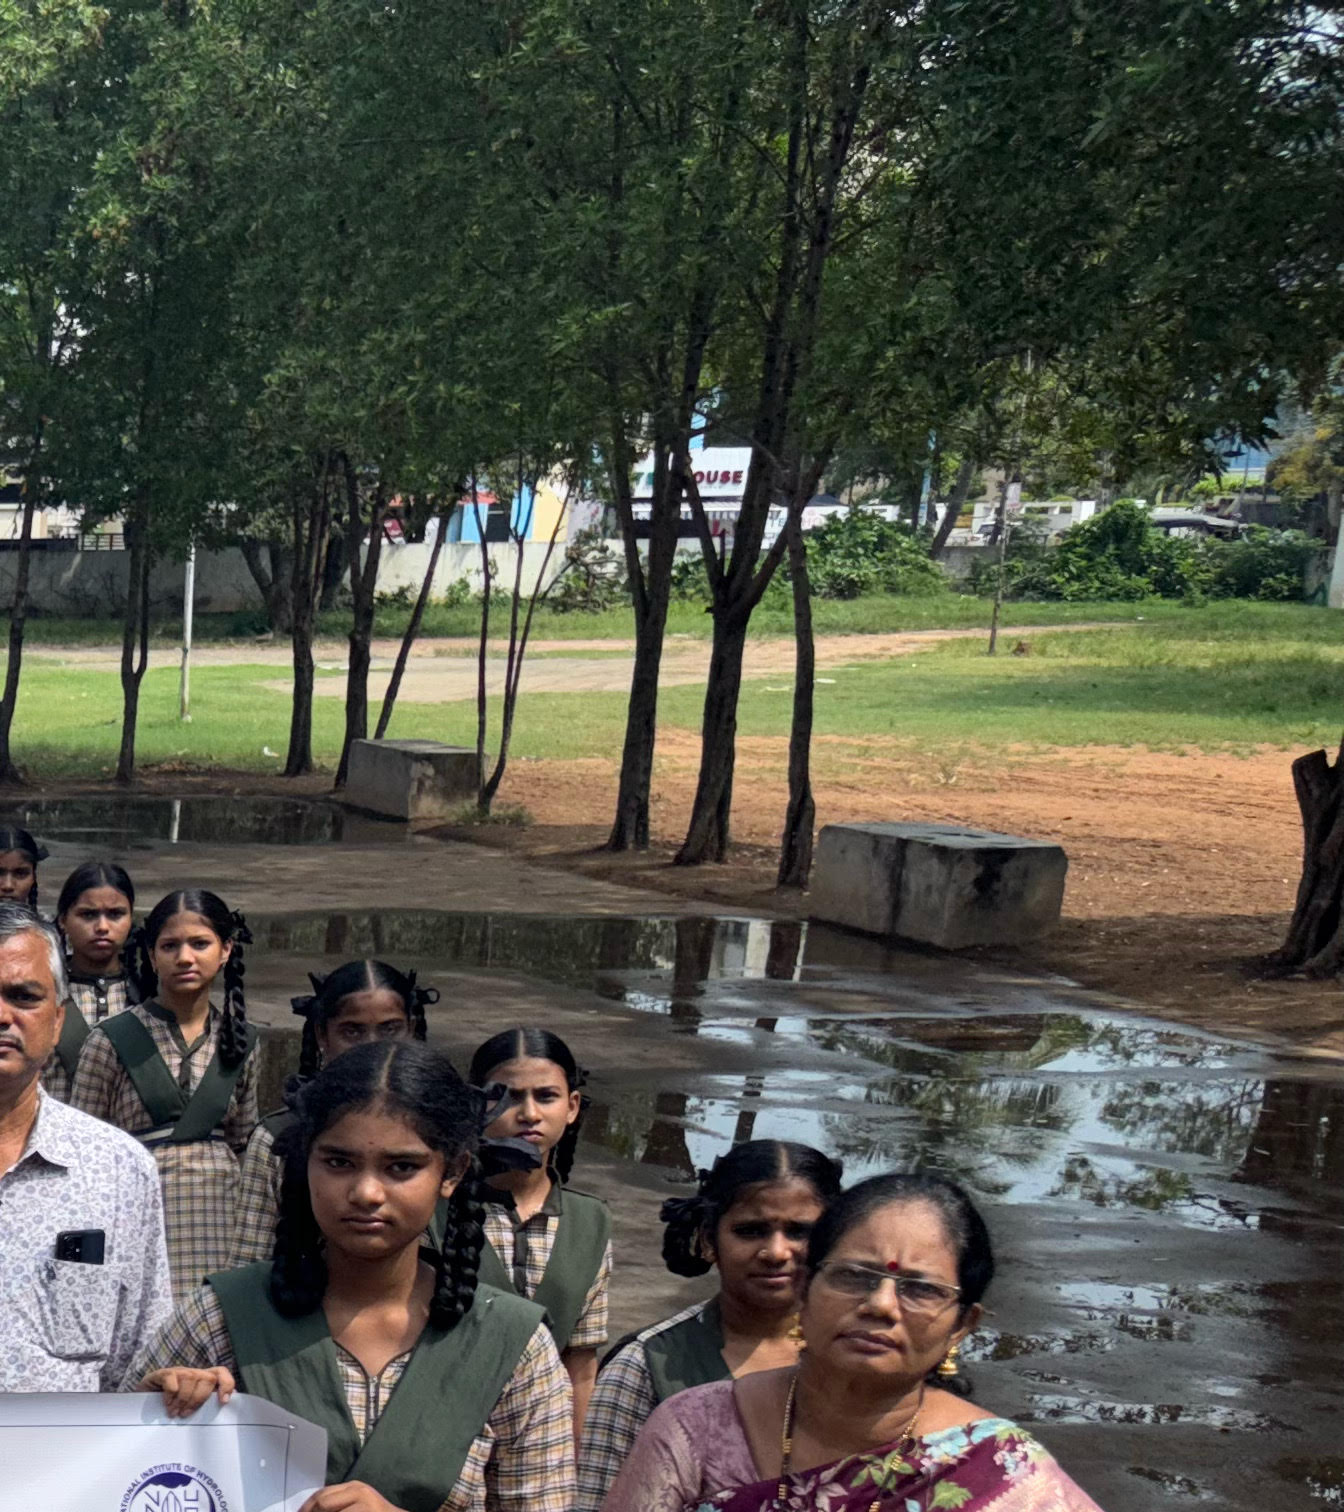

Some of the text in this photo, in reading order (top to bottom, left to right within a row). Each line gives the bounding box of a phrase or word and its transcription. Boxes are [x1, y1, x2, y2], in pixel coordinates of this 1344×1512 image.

[692, 469, 744, 485] OUSE
[141, 1463, 182, 1480] INSTITUTE
[184, 1464, 196, 1474] OF
